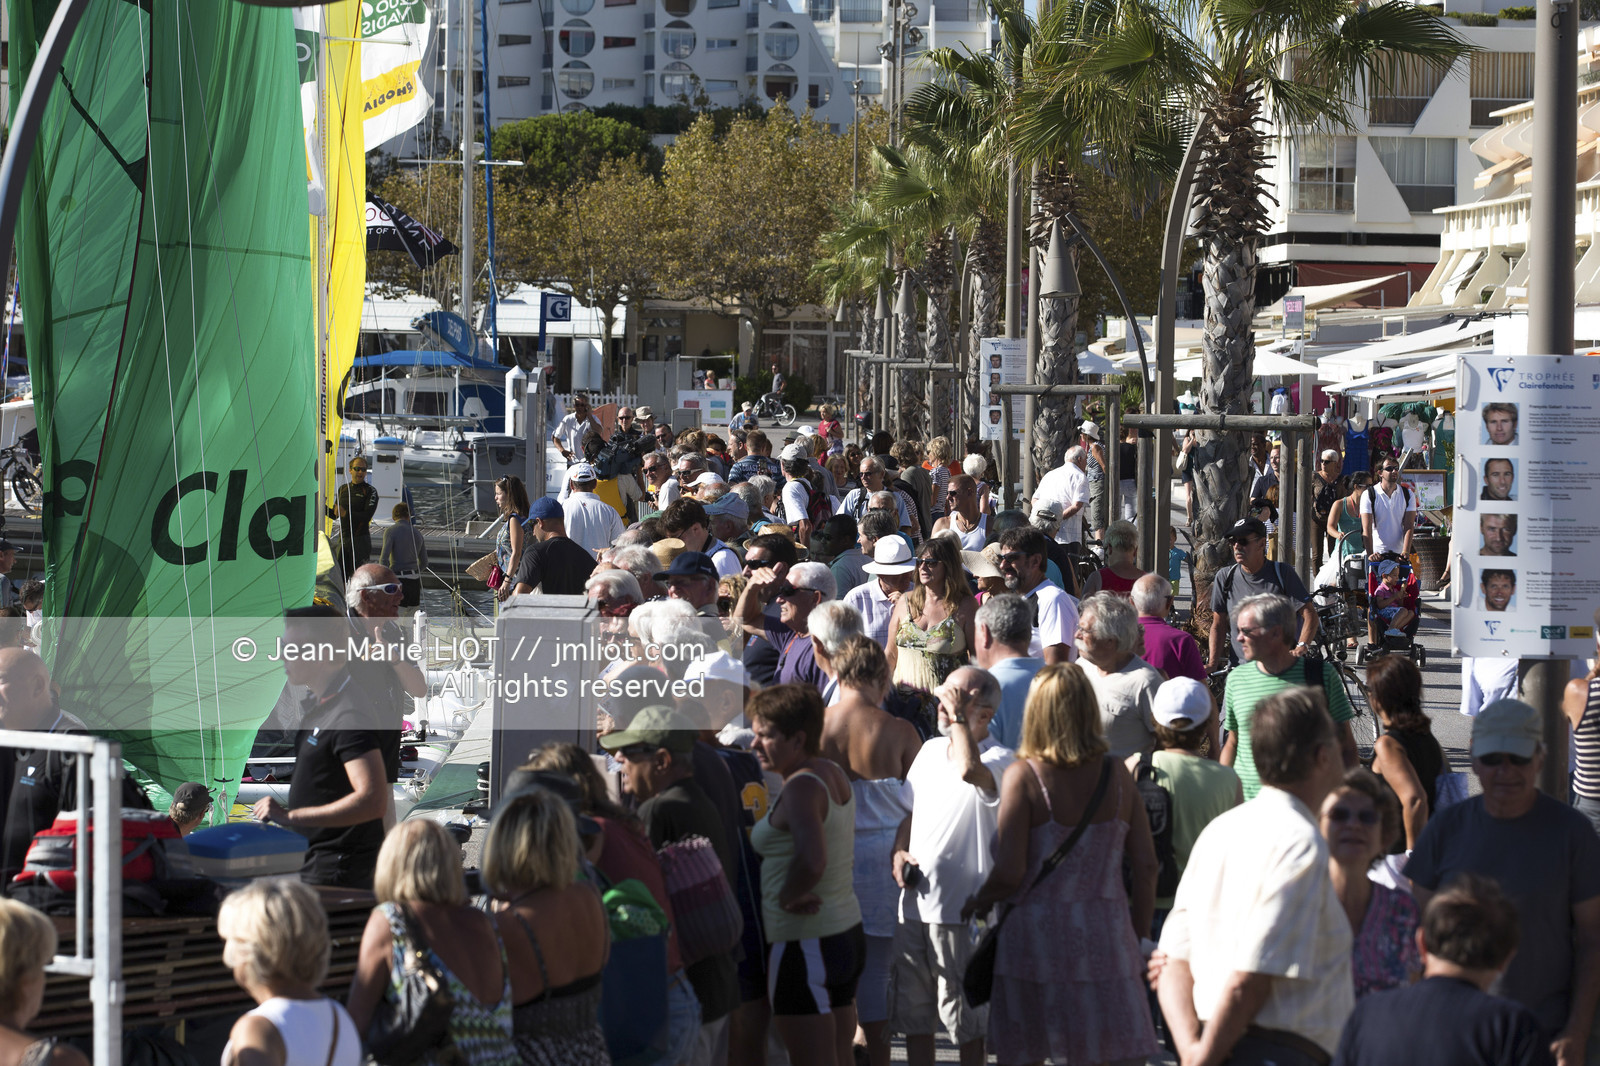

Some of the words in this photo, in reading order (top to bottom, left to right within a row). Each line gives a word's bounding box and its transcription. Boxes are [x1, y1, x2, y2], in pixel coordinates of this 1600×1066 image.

[550, 300, 568, 318] G
[1518, 372, 1576, 382] TROPHÉE
[1518, 382, 1575, 390] Clairefontaine
